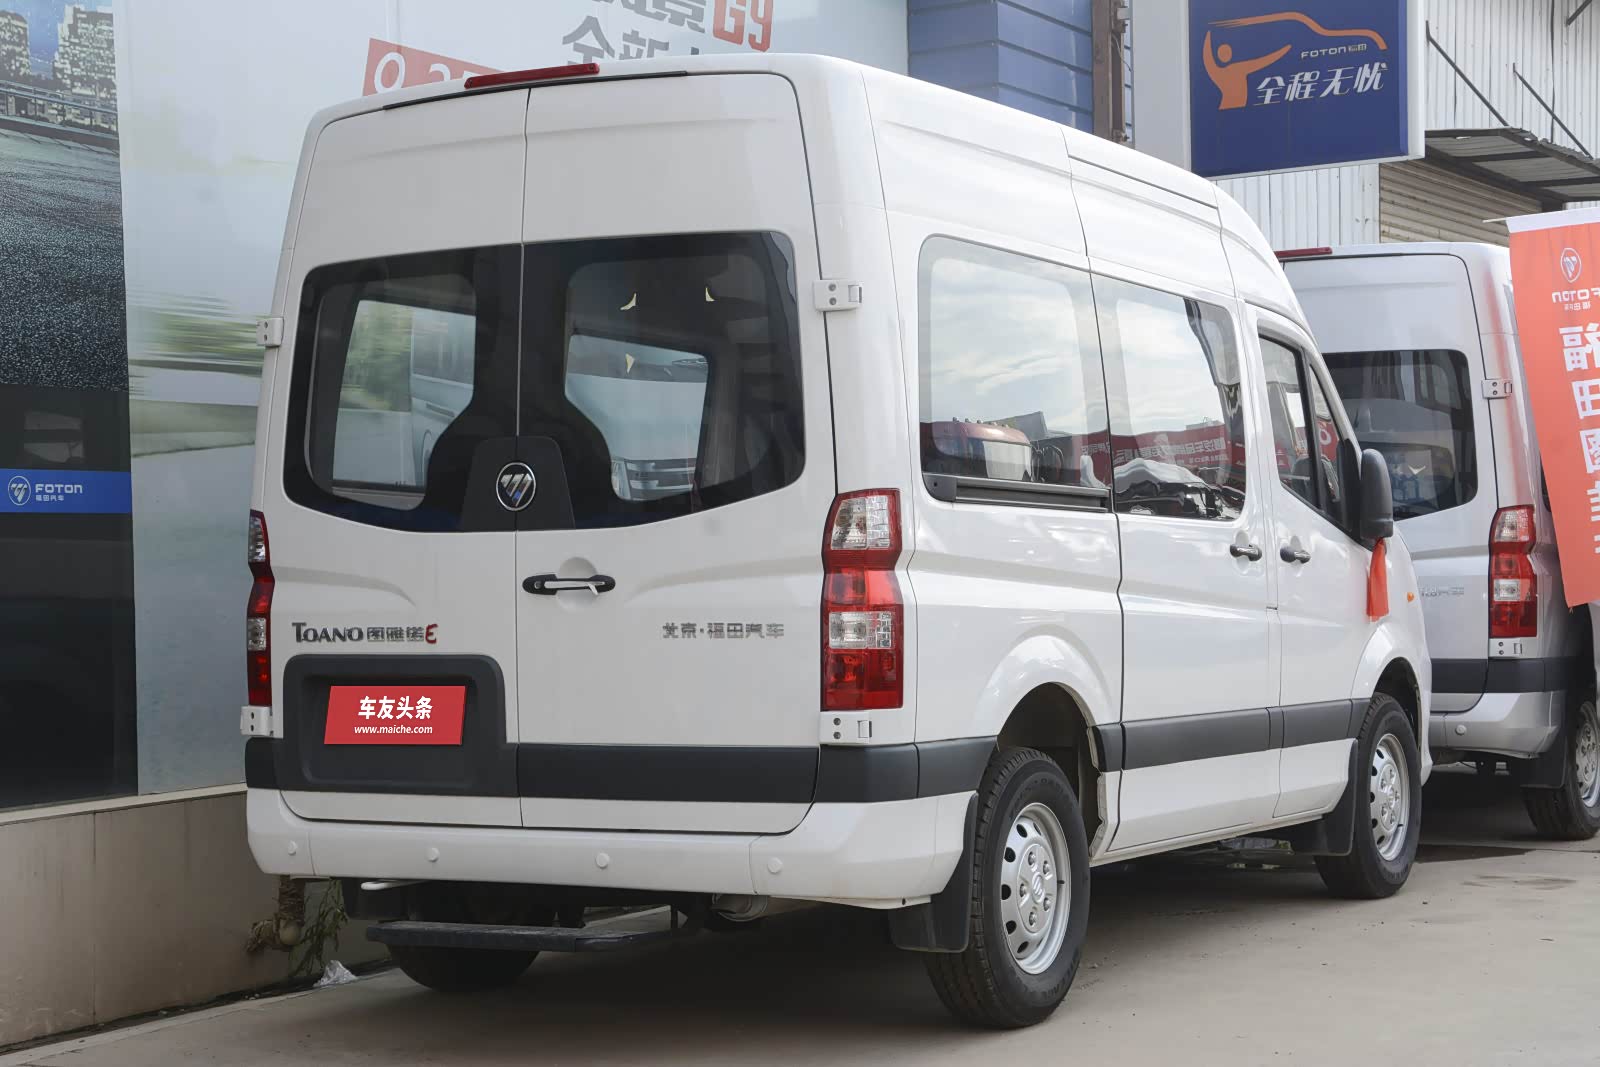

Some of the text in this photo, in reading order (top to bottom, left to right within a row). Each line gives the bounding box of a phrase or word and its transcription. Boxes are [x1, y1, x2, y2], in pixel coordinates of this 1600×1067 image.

[1301, 46, 1346, 59] FOTON
[1252, 62, 1389, 106] 全程无忧
[35, 483, 83, 494] FOTON
[292, 622, 364, 643] TOANO
